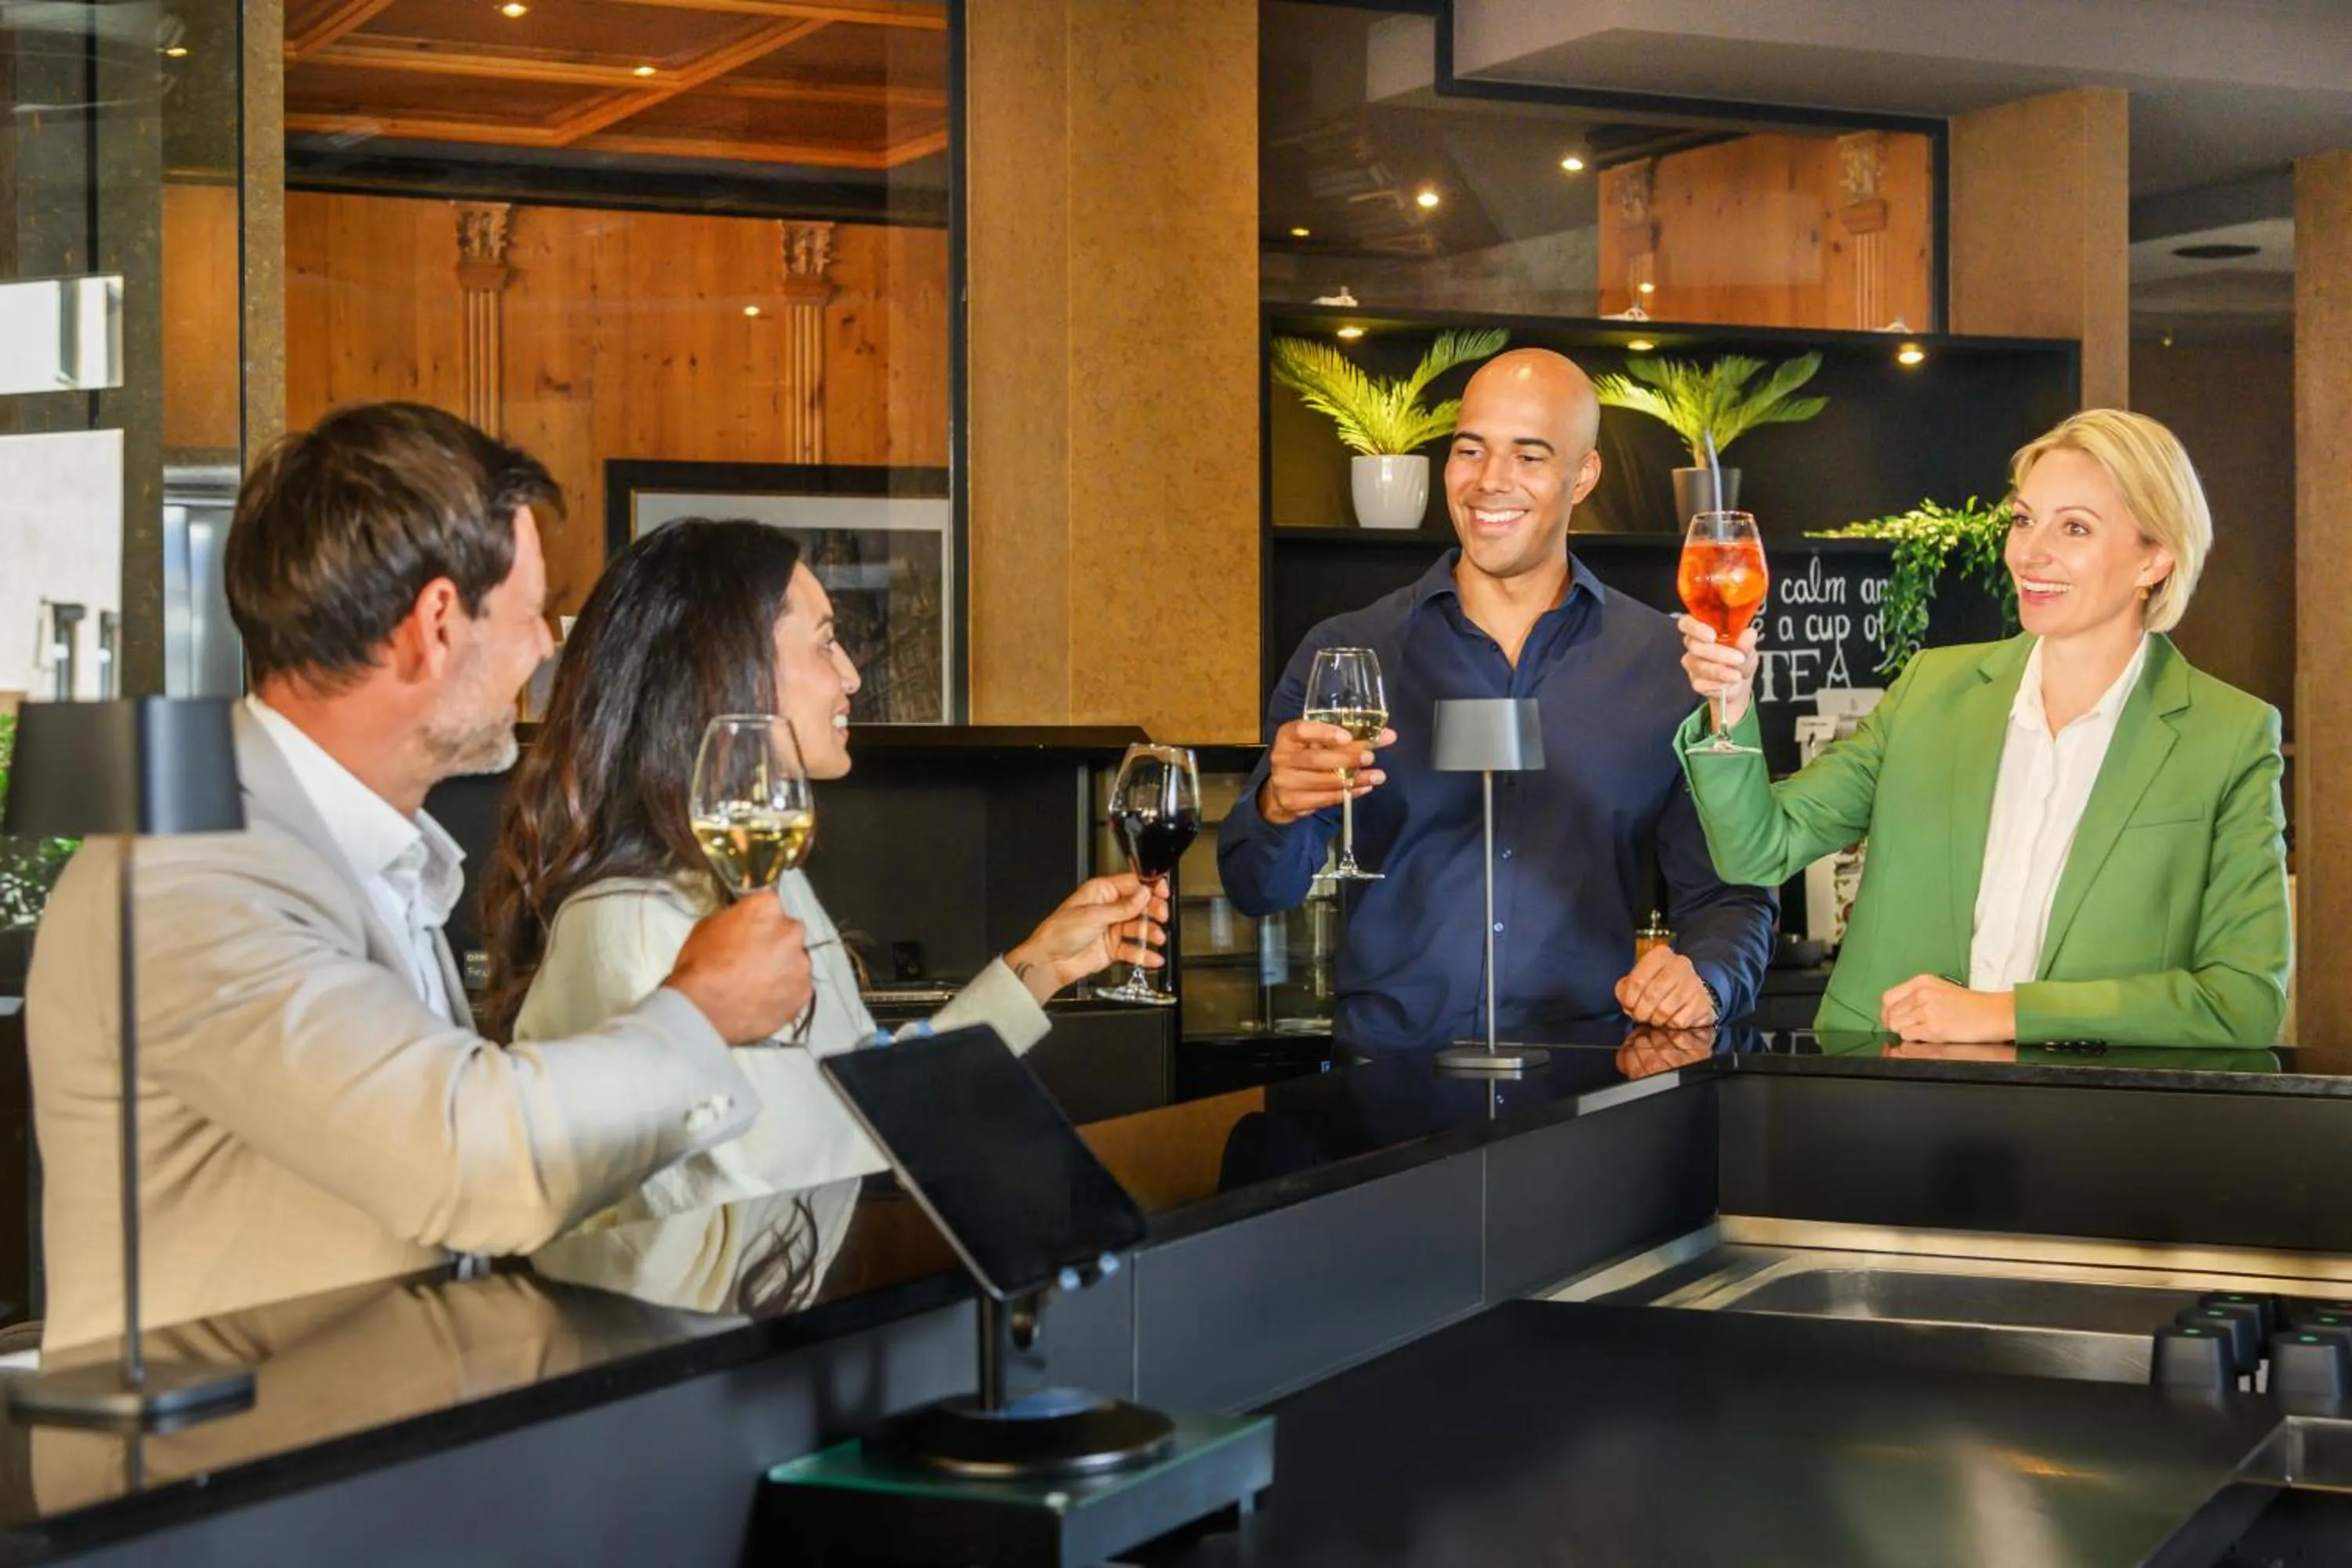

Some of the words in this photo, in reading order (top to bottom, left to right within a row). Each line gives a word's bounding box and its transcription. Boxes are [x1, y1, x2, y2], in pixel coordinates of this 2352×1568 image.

[1780, 555, 1846, 604] calm
[1860, 578, 1891, 604] an
[1778, 615, 1795, 641] a
[1806, 614, 1850, 647] cup
[1757, 644, 1852, 702] TEA
